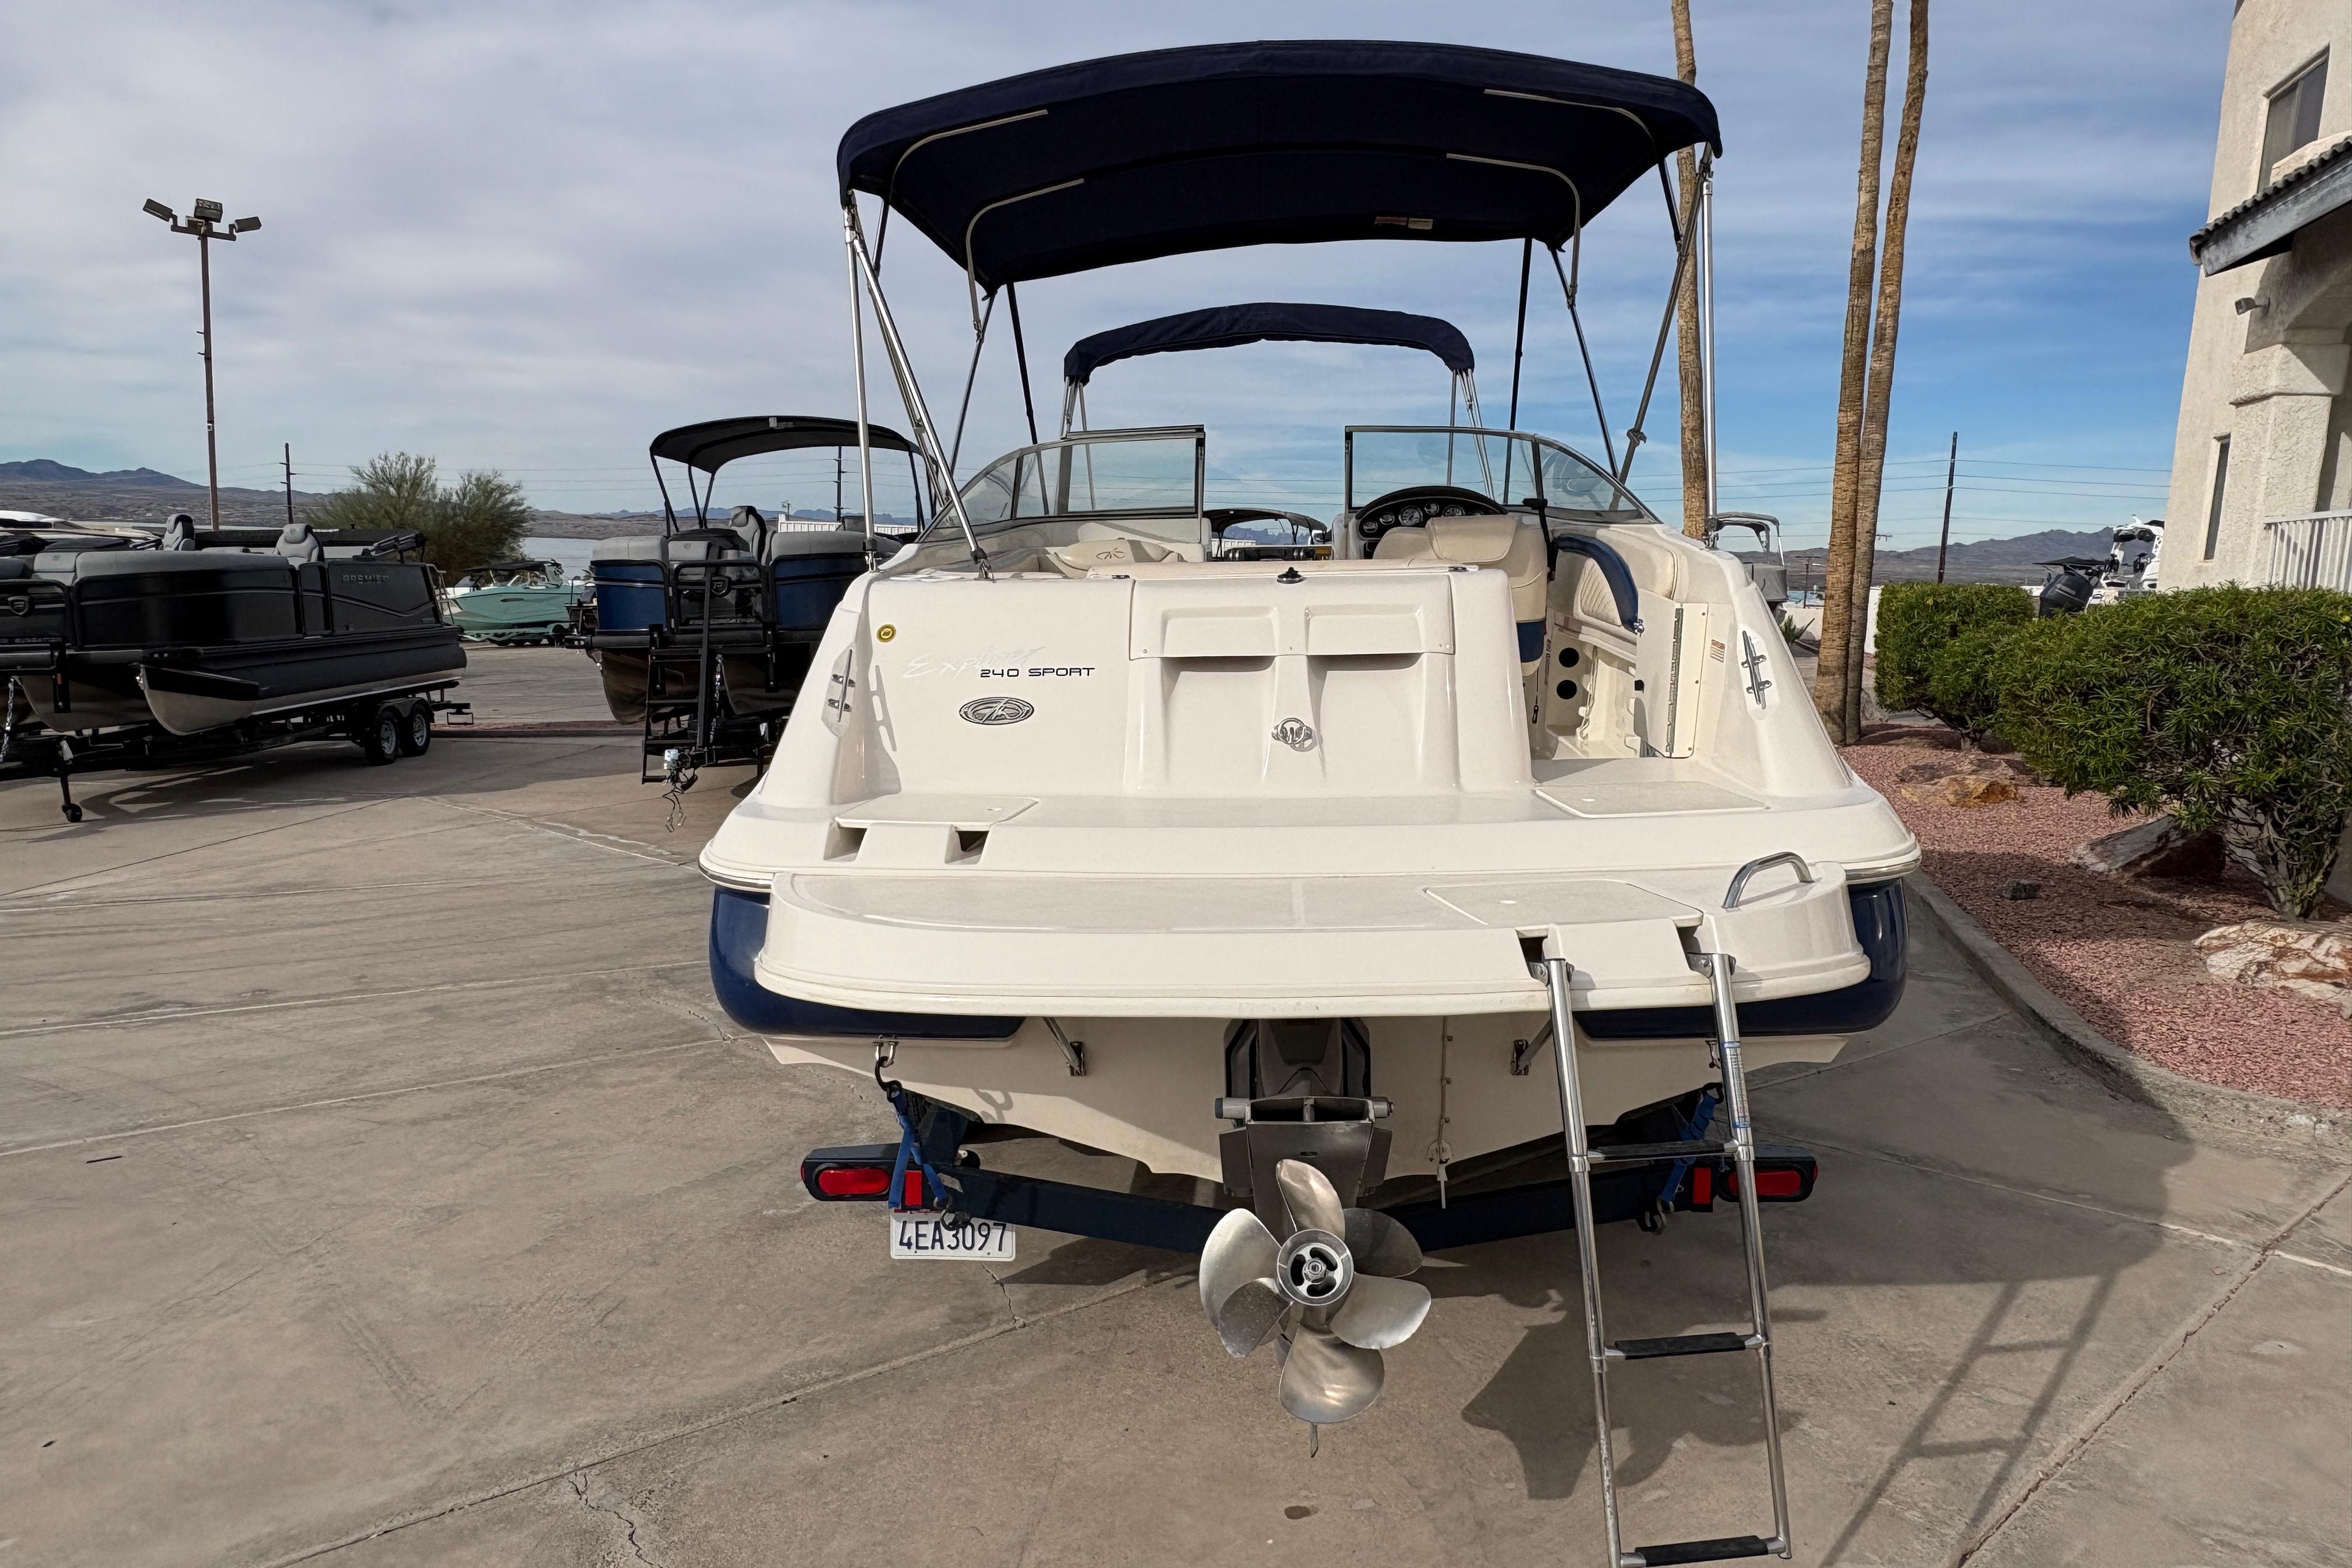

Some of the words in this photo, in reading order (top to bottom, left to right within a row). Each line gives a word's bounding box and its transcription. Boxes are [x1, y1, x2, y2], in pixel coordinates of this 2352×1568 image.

[980, 668, 1020, 677] 240
[1028, 667, 1095, 677] SPORT
[899, 1220, 1007, 1252] 4EA3097
